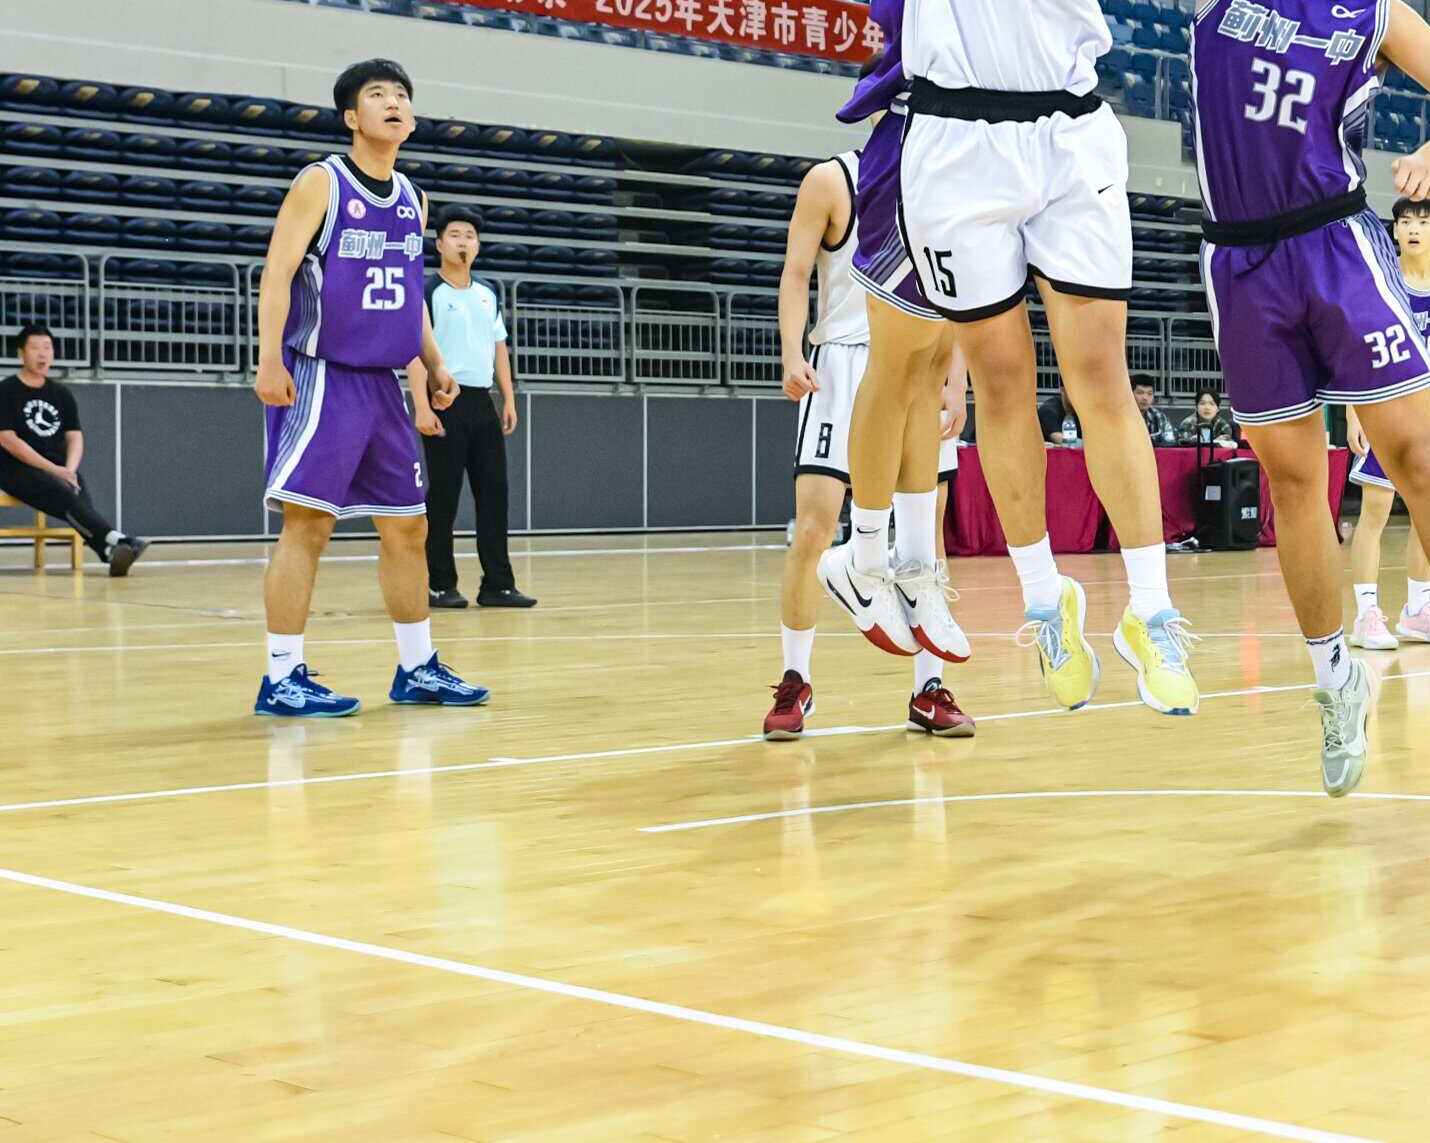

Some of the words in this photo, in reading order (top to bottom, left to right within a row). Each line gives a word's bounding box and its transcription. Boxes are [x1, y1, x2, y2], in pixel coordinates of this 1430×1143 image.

[1244, 57, 1316, 135] 32
[338, 228, 423, 262] 蓟州一中
[362, 267, 406, 310] 25
[923, 246, 957, 298] 15
[1363, 323, 1412, 369] 32
[814, 422, 834, 459] 8
